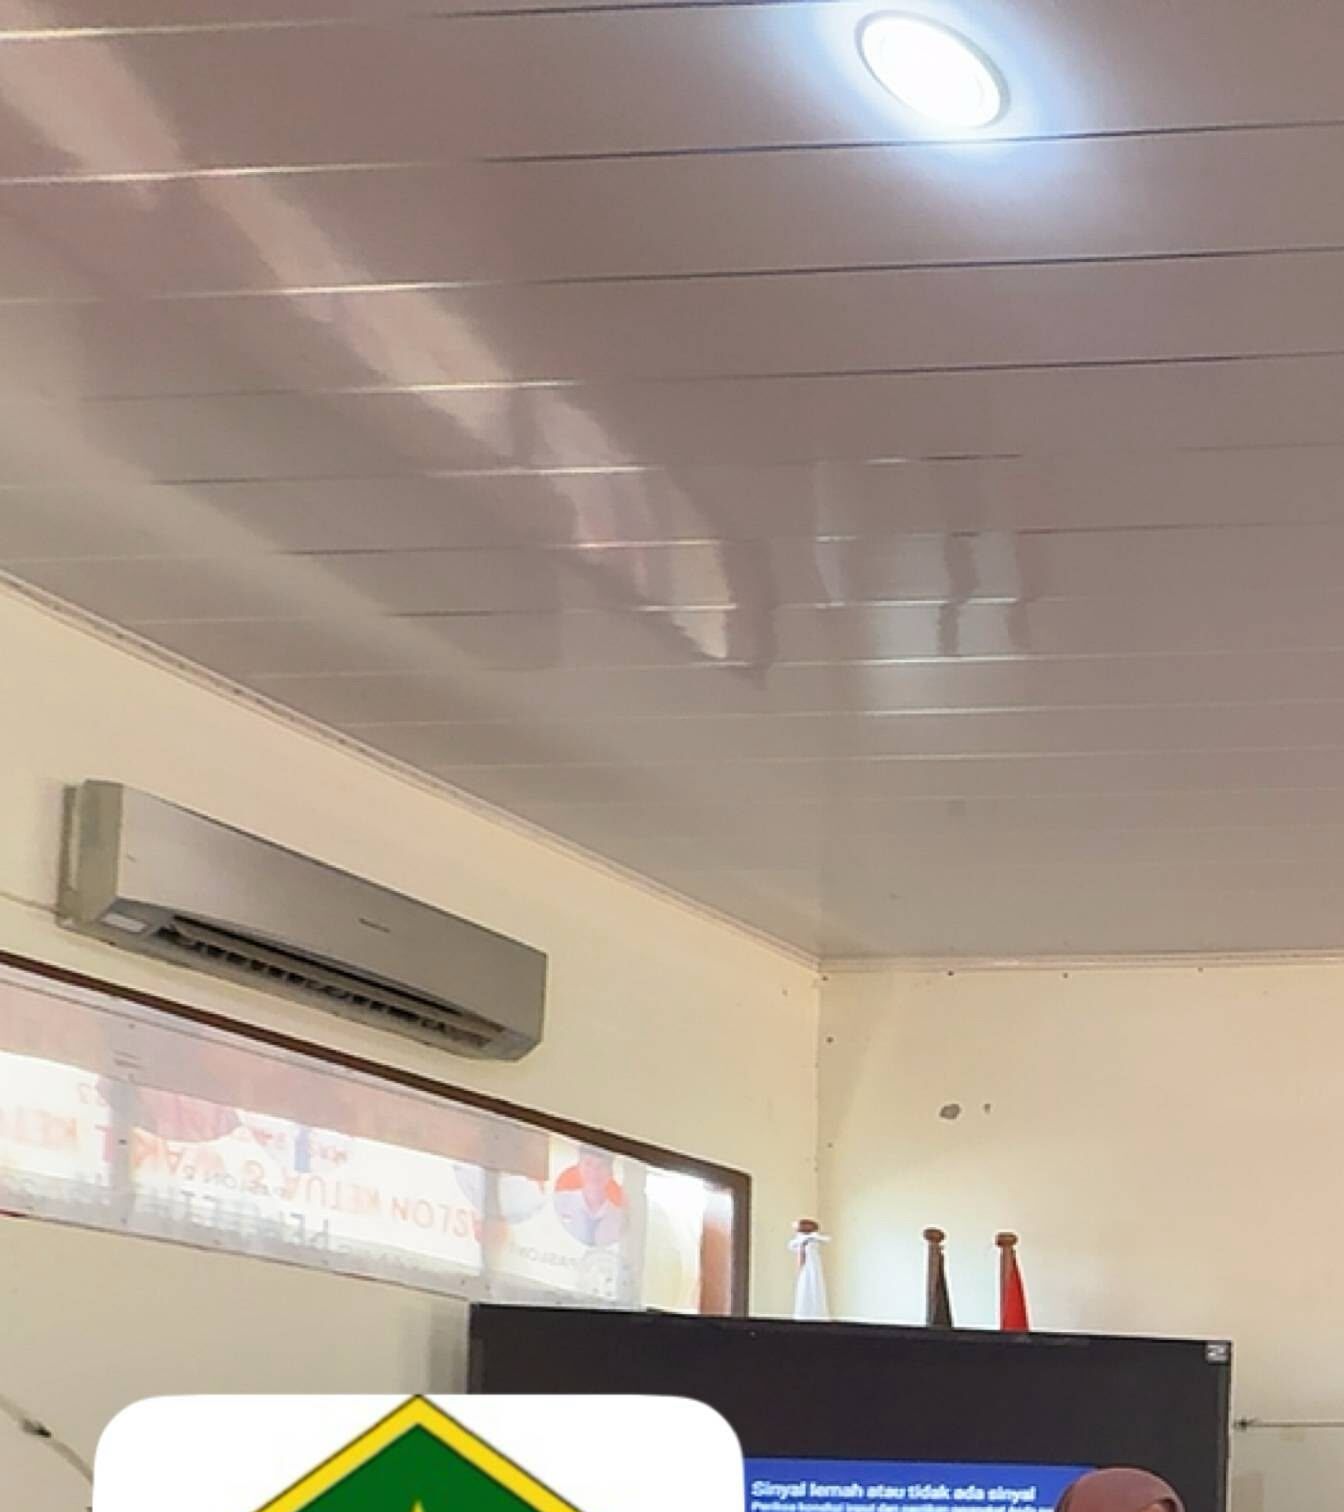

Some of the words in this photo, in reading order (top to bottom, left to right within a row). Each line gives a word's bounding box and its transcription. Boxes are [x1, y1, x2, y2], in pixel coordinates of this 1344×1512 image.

[751, 1480, 807, 1500] Sinyal
[809, 1481, 865, 1498] lemah
[866, 1484, 906, 1499] atau
[907, 1483, 950, 1500] tidak
[987, 1485, 1037, 1505] sinyal
